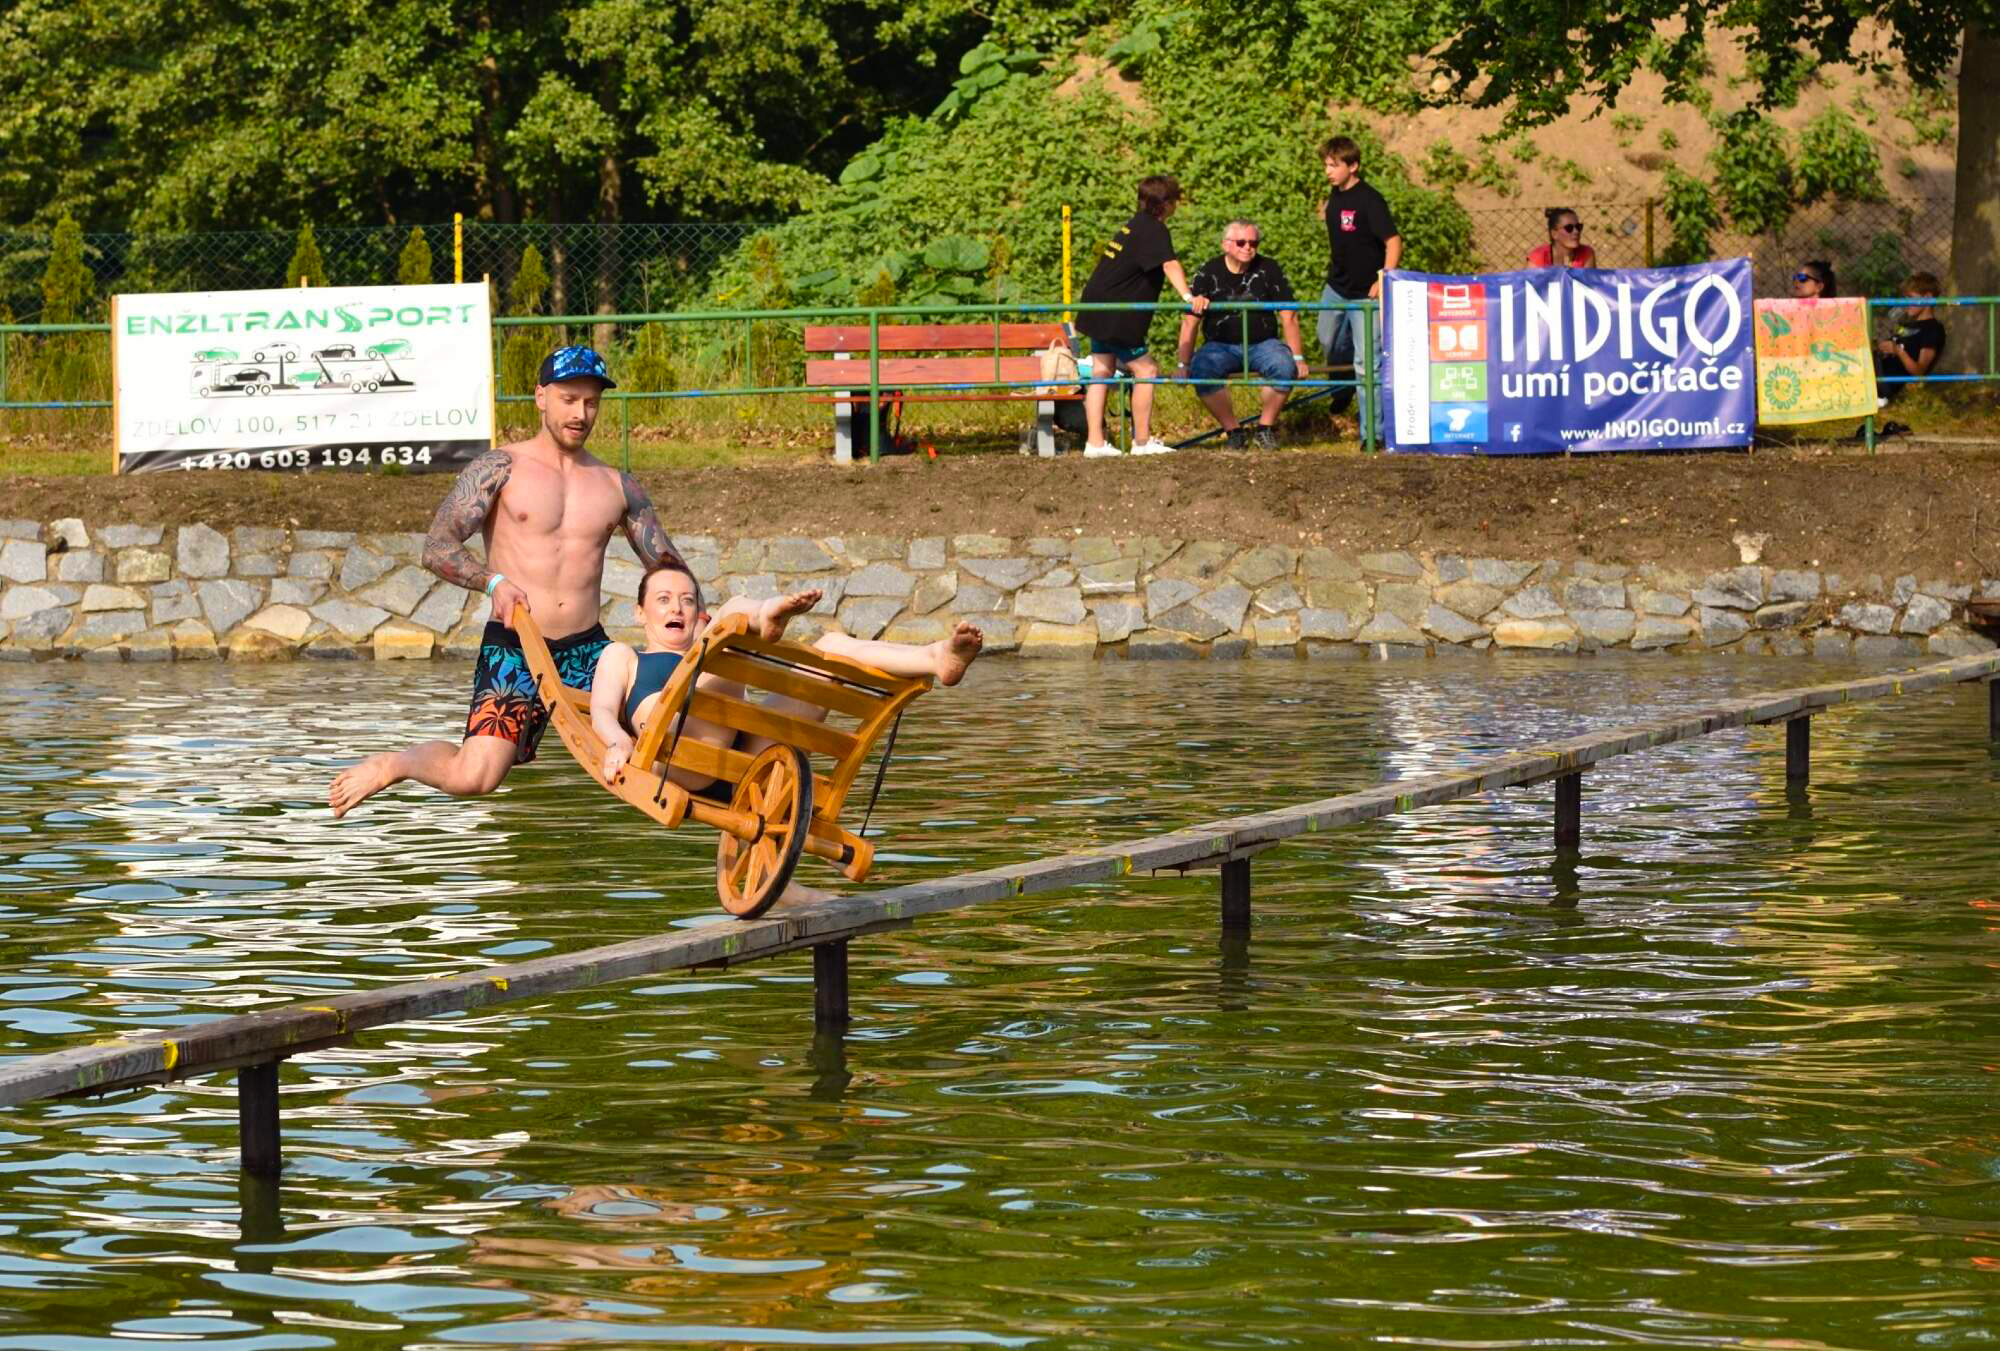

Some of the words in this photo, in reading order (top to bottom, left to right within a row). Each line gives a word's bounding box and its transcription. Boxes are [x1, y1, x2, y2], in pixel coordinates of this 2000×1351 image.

[1500, 273, 1742, 362] INDIGO
[1502, 364, 1569, 398] umí
[1584, 357, 1742, 405] počítače
[132, 417, 221, 437] ZDELOV
[235, 415, 283, 434] 100,
[296, 413, 336, 430] 517
[349, 412, 373, 428] 21
[387, 407, 478, 428] ZDELOV
[1560, 417, 1745, 441] www.INDIGOumi.cz
[180, 451, 251, 471] +420
[260, 448, 310, 468] 603
[322, 447, 371, 466] 194
[381, 445, 432, 465] 634
